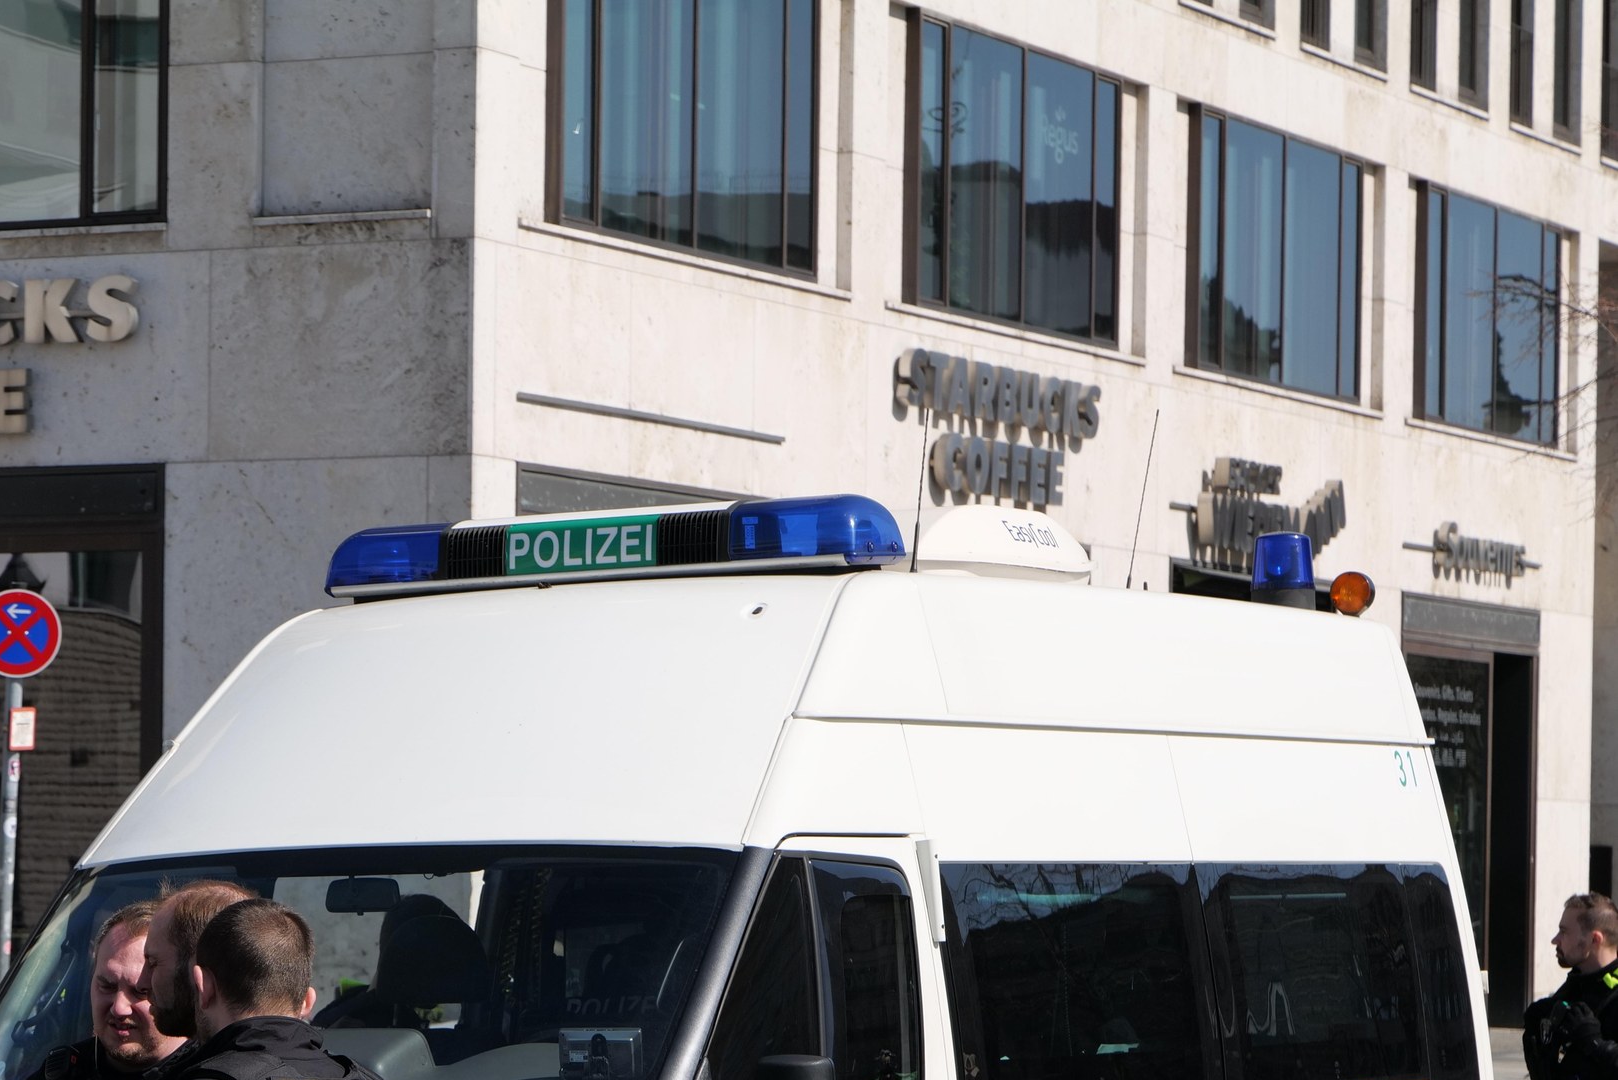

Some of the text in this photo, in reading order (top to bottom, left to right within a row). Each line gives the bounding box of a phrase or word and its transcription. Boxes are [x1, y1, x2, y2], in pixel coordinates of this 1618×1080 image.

[895, 348, 1102, 440] STARBUCKS
[931, 432, 1065, 506] COFFEE
[508, 523, 654, 571] POLIZEI
[1393, 749, 1418, 788] 31
